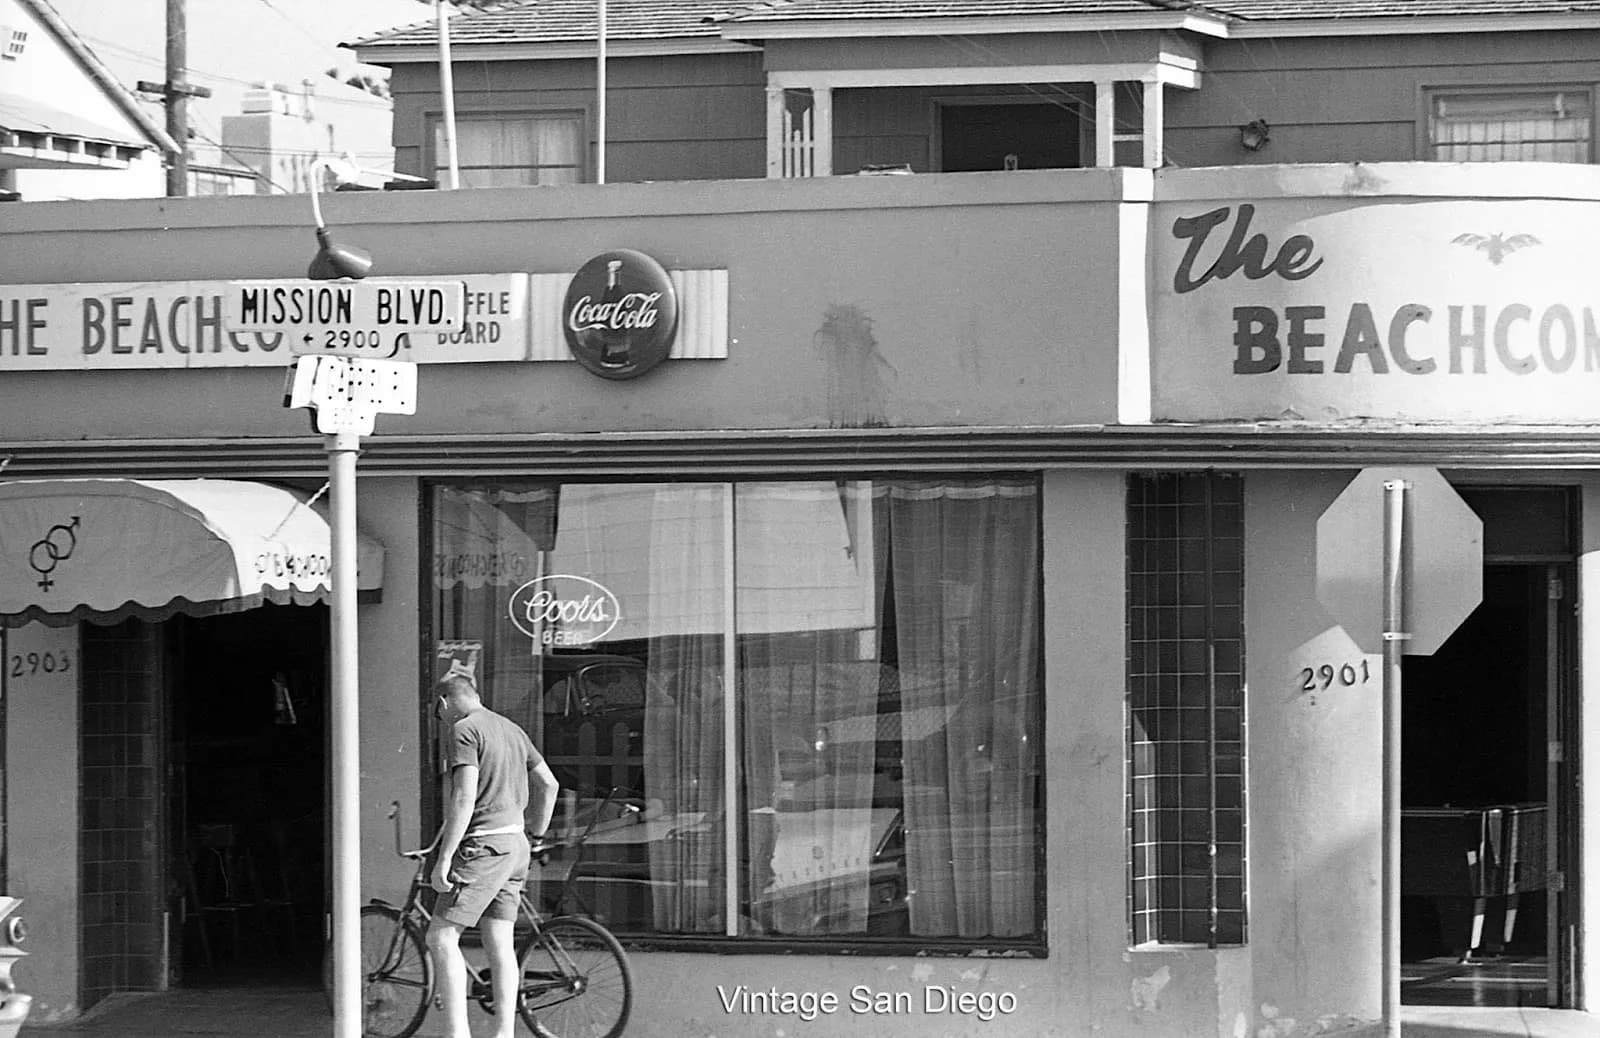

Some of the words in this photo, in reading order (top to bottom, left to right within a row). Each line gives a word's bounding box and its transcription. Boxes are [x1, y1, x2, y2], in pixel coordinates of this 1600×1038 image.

[1172, 203, 1324, 294] The
[241, 288, 351, 324] MISSION
[377, 289, 452, 325] BLVD.
[569, 291, 663, 332] Coca-Cola
[325, 330, 380, 349] 2900
[523, 590, 609, 622] Coors
[11, 649, 70, 679] 2903
[1301, 658, 1370, 692] 2901
